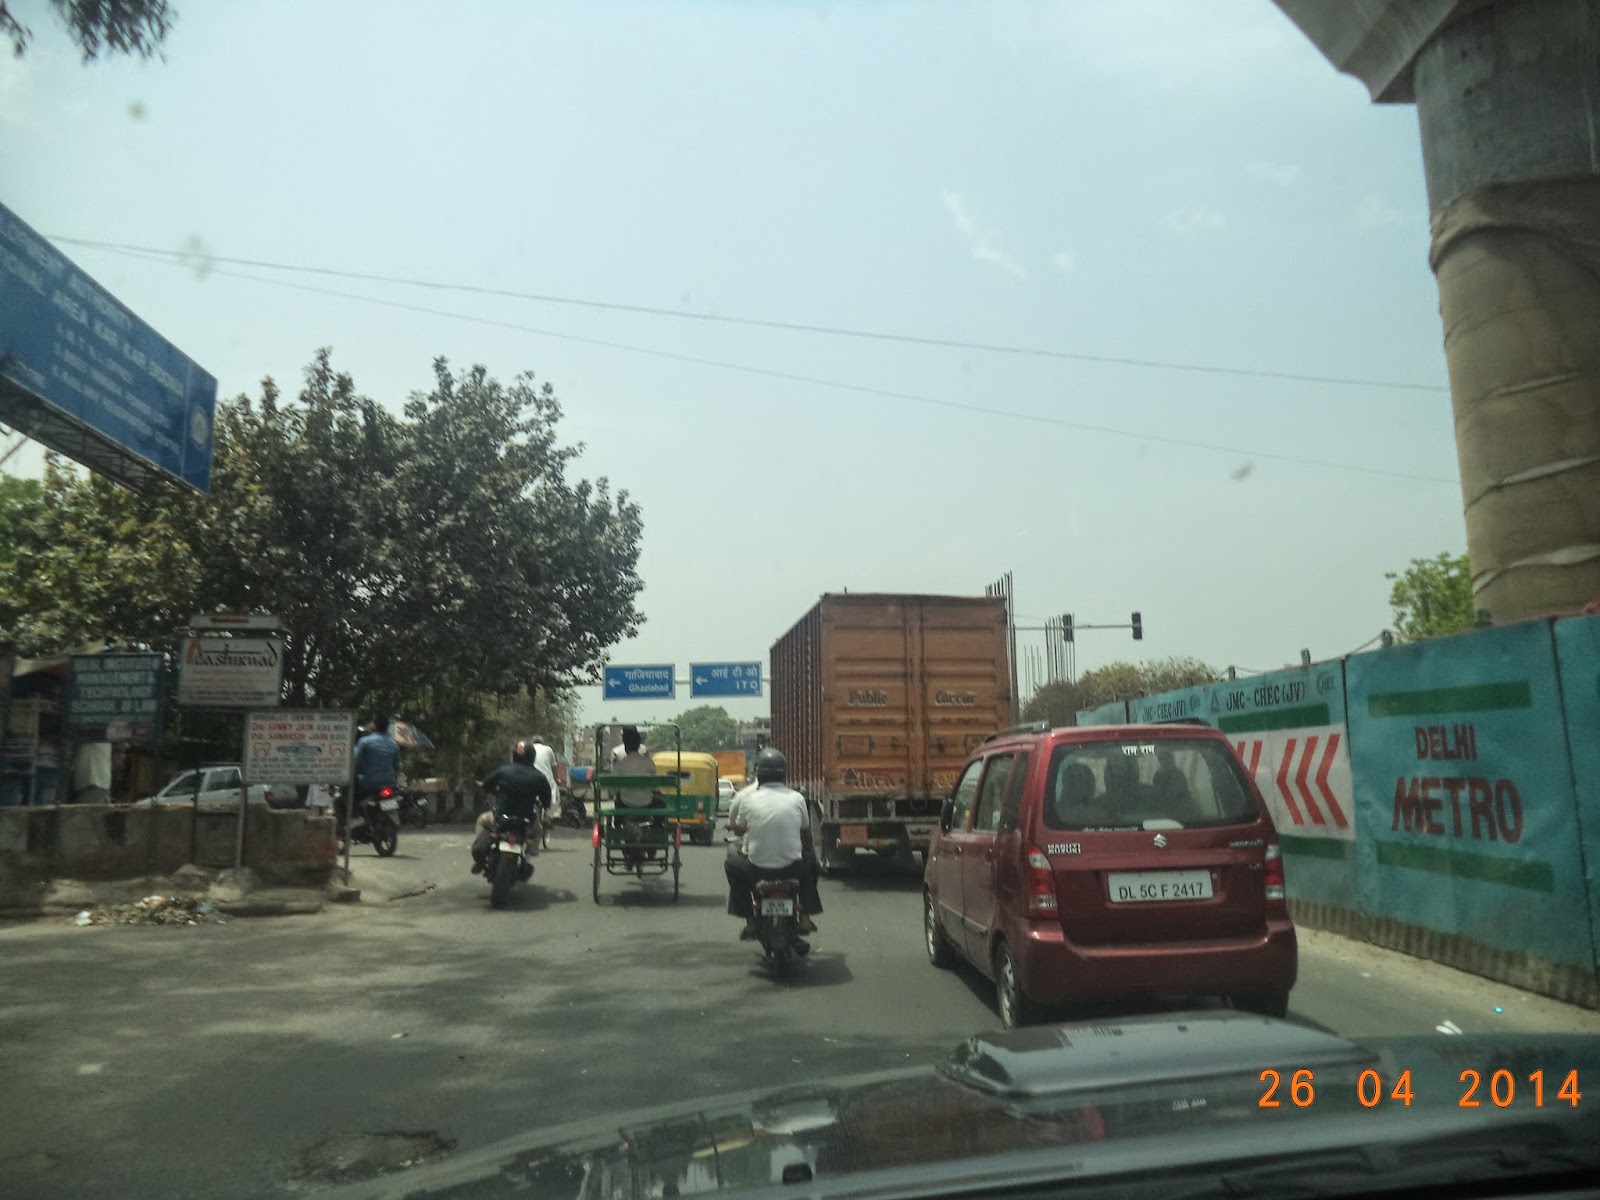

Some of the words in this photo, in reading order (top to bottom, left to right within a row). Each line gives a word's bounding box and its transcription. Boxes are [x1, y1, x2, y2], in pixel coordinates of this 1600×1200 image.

[628, 683, 669, 692] Ghaziabad
[849, 690, 887, 707] Public
[1227, 691, 1245, 711] JMC
[1415, 722, 1478, 761] DELHI
[1121, 746, 1137, 757] राम
[1140, 744, 1155, 756] राम
[1391, 776, 1524, 844] METRO
[1119, 886, 1136, 900] DL
[1172, 883, 1203, 897] 2417
